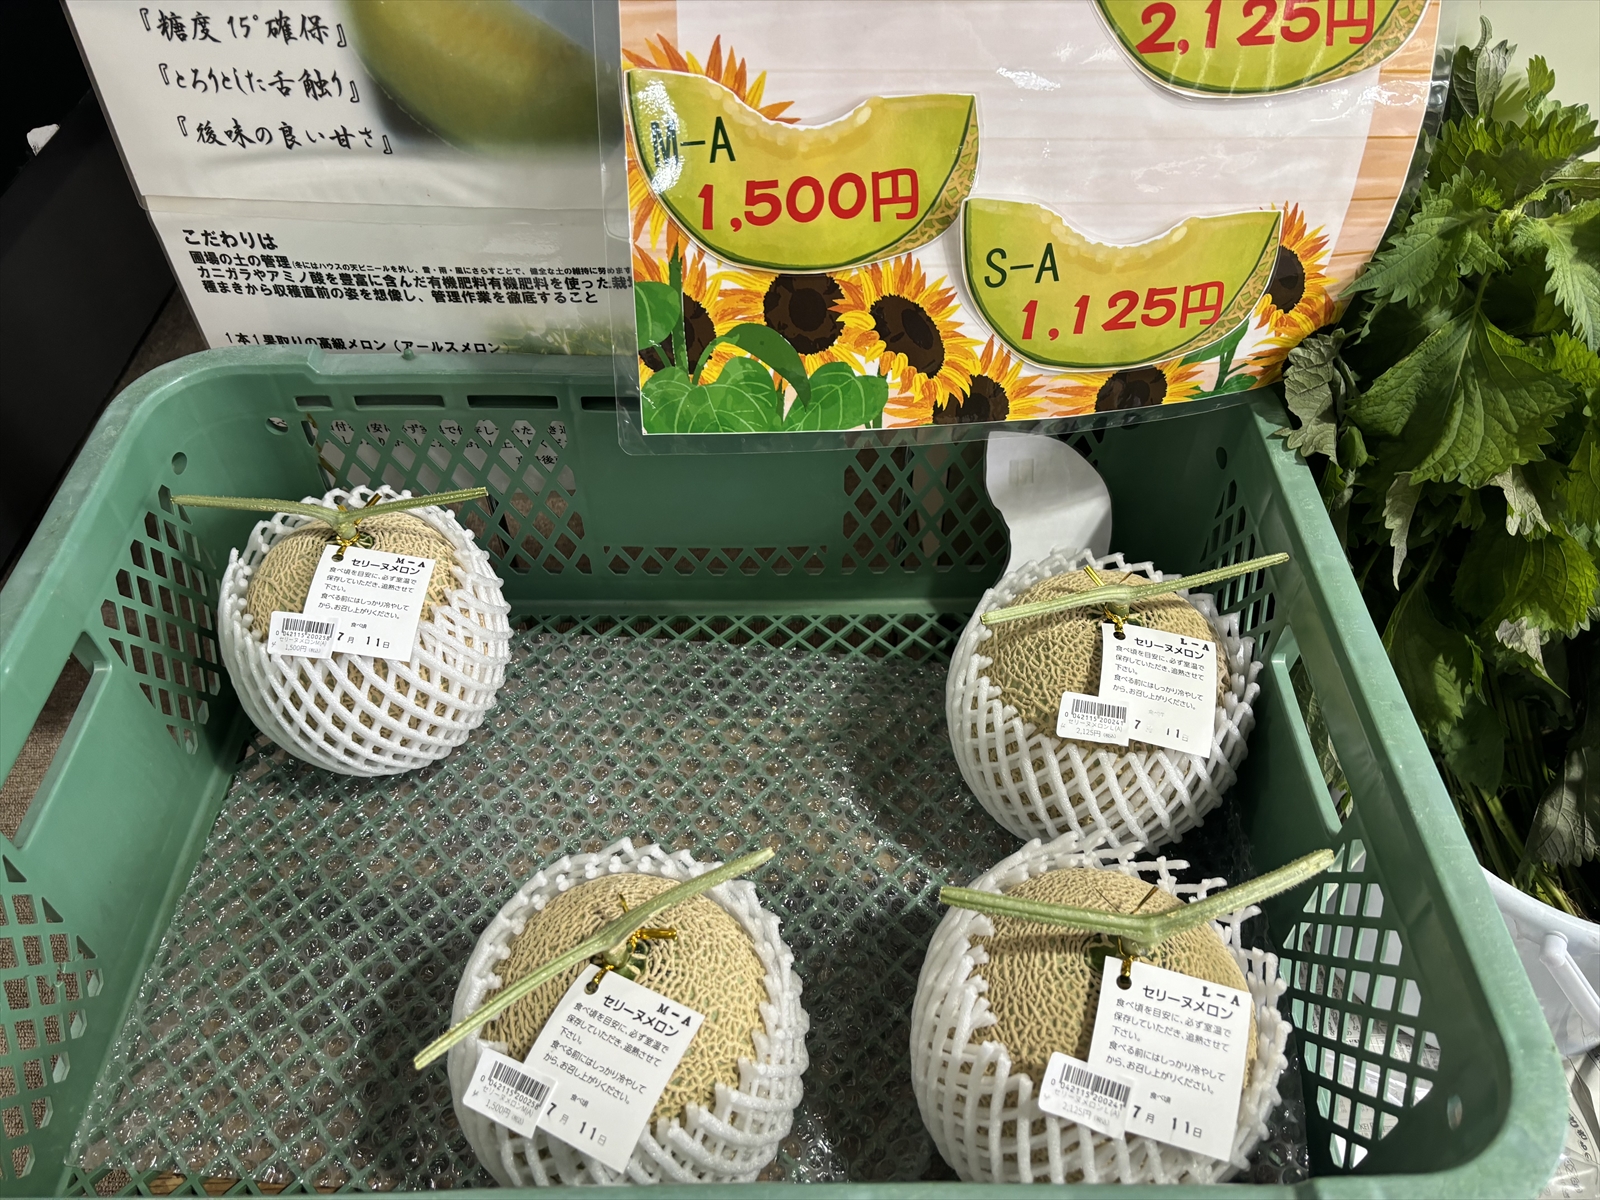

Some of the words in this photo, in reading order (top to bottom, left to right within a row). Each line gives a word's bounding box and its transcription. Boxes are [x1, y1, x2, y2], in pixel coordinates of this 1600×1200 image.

[1135, 0, 1375, 55] 2,125円
[177, 115, 393, 155] 『後味の良い甘さ』
[698, 168, 919, 232] 1,500円
[182, 229, 278, 250] こだわりは
[984, 242, 1060, 288] S-A
[201, 280, 598, 304] 種まきから収穫直前の姿を想像し、管理作業を徹底すること
[1021, 280, 1224, 341] 1,125円
[329, 566, 417, 586] 食べ頃を目安に、必ず室温で
[351, 558, 420, 575] セリーヌメロン
[324, 583, 346, 593] 下さい。
[326, 575, 415, 594] 保存していただき、追熟させて
[318, 602, 400, 620] から、お召し上がりください。
[320, 592, 409, 612] 食べる前にはしっかり冷やして
[1115, 645, 1205, 671] 食べ頃を目安に、必ず室温で
[1134, 637, 1205, 660] セリーヌメロン
[1115, 654, 1204, 681] 保存していただき、追熟させて
[1115, 664, 1138, 675] 下さい。
[1112, 684, 1196, 710] から、お召し上がりください。
[1113, 674, 1203, 701] 食べる前にはしっかり冷やして
[603, 994, 680, 1038] セリーヌメロン
[1142, 985, 1234, 1020] セリーヌメロン
[573, 1001, 670, 1054] 食べ頃を目安に、必ず室温で
[1116, 997, 1232, 1038] 食べ頃を目安に、必ず室温で
[560, 1025, 583, 1045] 下さい。
[566, 1013, 662, 1067] 保存していただき、追熟させて
[1112, 1025, 1142, 1042] 下さい。
[1113, 1011, 1230, 1053] 保存していただき、追熟させて
[550, 1039, 647, 1095] 食べる前にはしっかり冷やして
[1105, 1054, 1215, 1095] から、お召し上がりください。
[1108, 1040, 1226, 1083] 食べる前にはしっかり冷やして
[543, 1052, 632, 1105] から、お召し上がりください。
